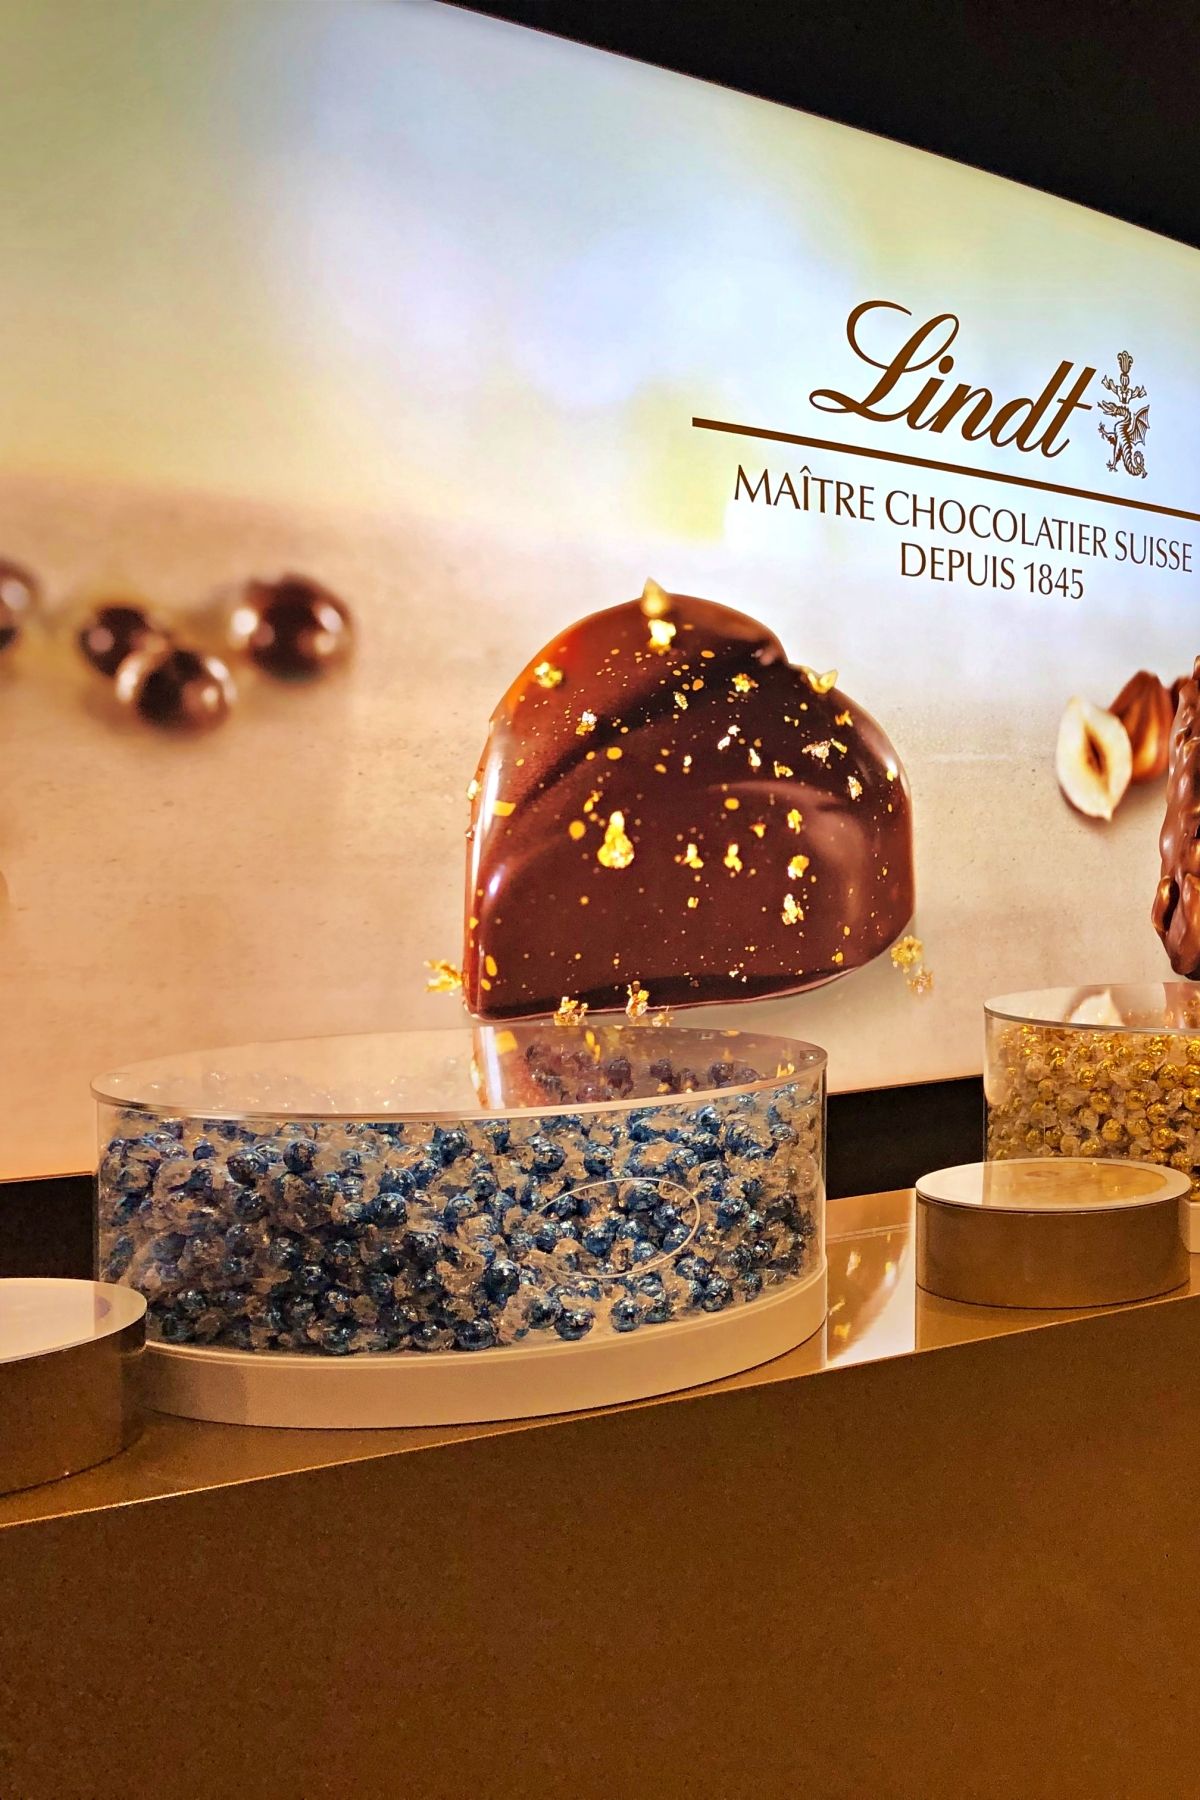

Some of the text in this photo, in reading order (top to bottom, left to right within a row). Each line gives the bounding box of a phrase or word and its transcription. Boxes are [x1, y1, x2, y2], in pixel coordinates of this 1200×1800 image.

[809, 300, 1096, 458] Lindt
[734, 464, 1193, 573] MAÎTRE CHOCOLATIER SUISSE
[900, 542, 1084, 599] DEPUIS 1845
